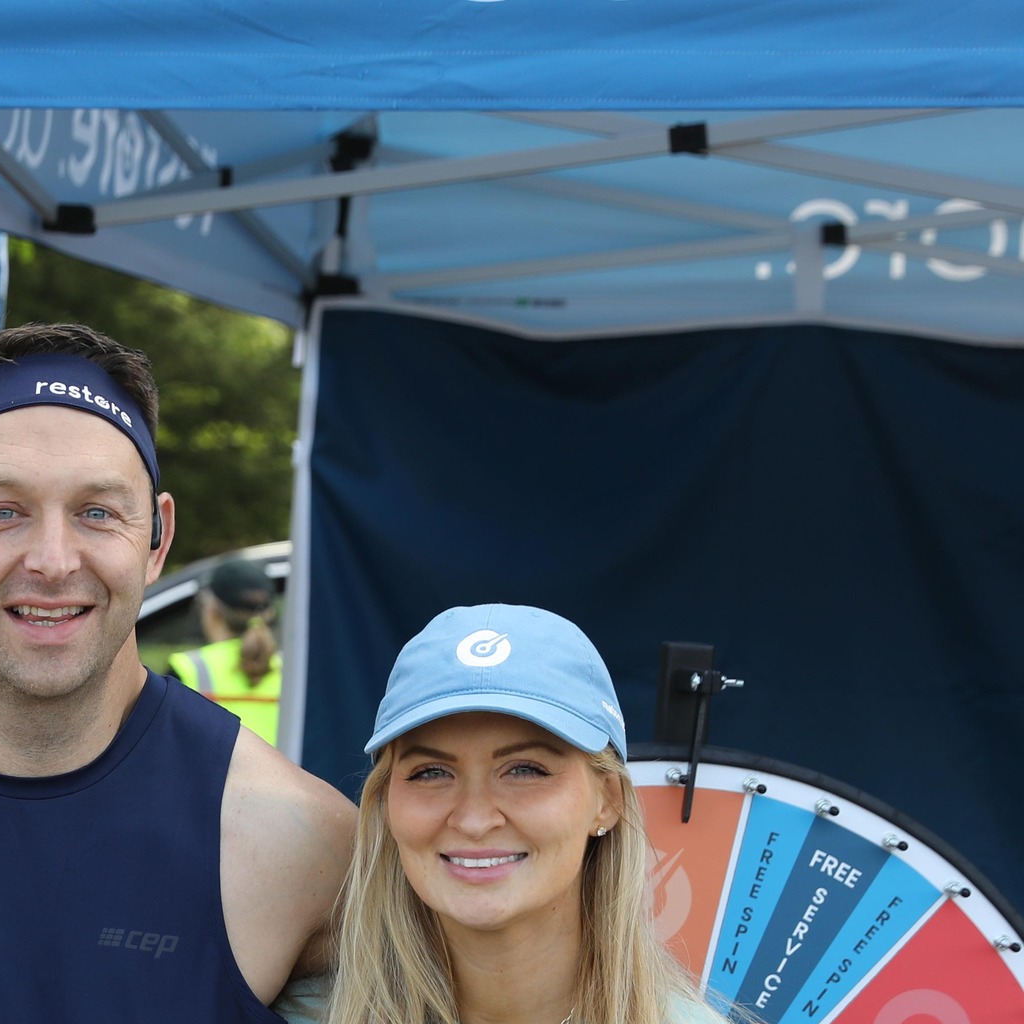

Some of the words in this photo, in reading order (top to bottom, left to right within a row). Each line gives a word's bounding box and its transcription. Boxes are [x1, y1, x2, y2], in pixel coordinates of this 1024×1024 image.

[35, 381, 133, 428] restore
[809, 849, 863, 889] FREE
[124, 930, 180, 959] cep
[755, 887, 828, 1009] SERVICE
